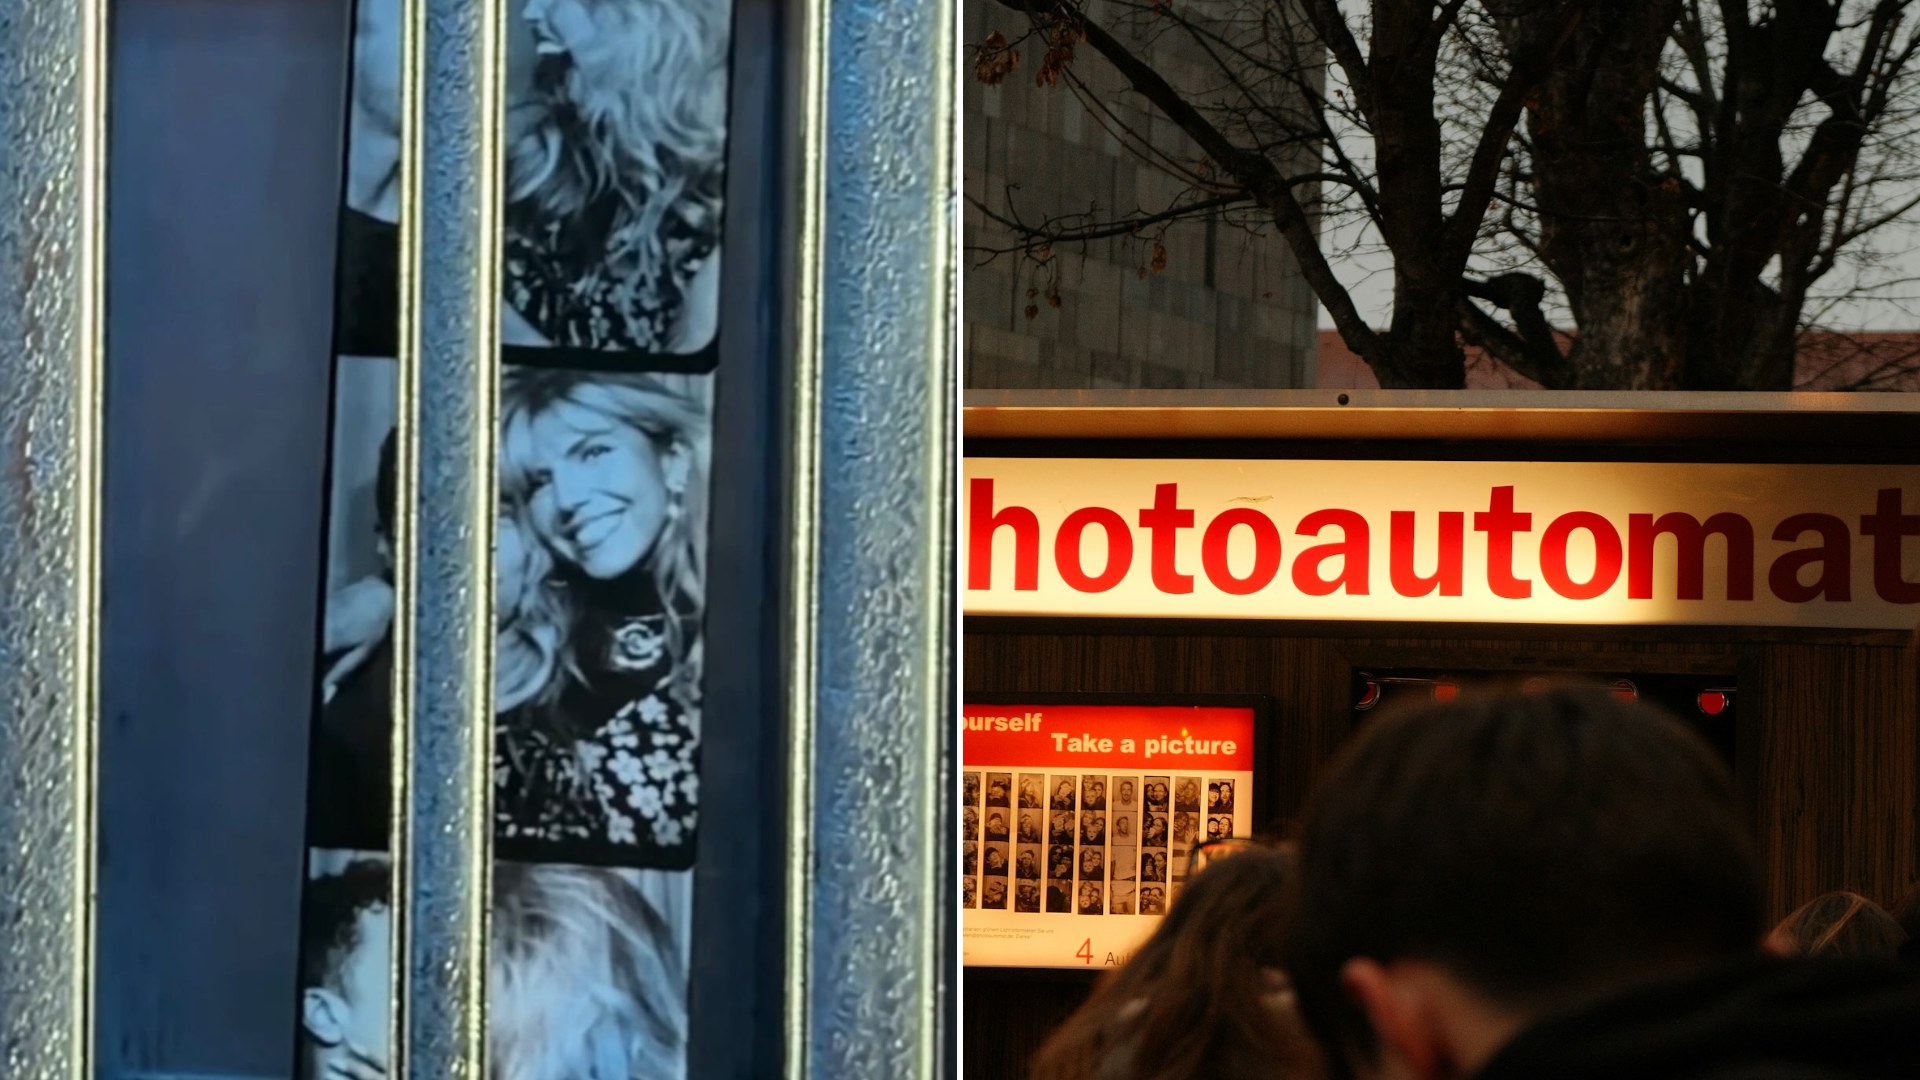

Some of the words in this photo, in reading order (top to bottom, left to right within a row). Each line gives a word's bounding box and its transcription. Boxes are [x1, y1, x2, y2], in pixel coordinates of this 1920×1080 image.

[968, 478, 1920, 605] hotoautomat
[1051, 732, 1114, 752] Take
[1120, 738, 1136, 753] a
[1145, 735, 1237, 758] picture
[1076, 937, 1094, 965] 4
